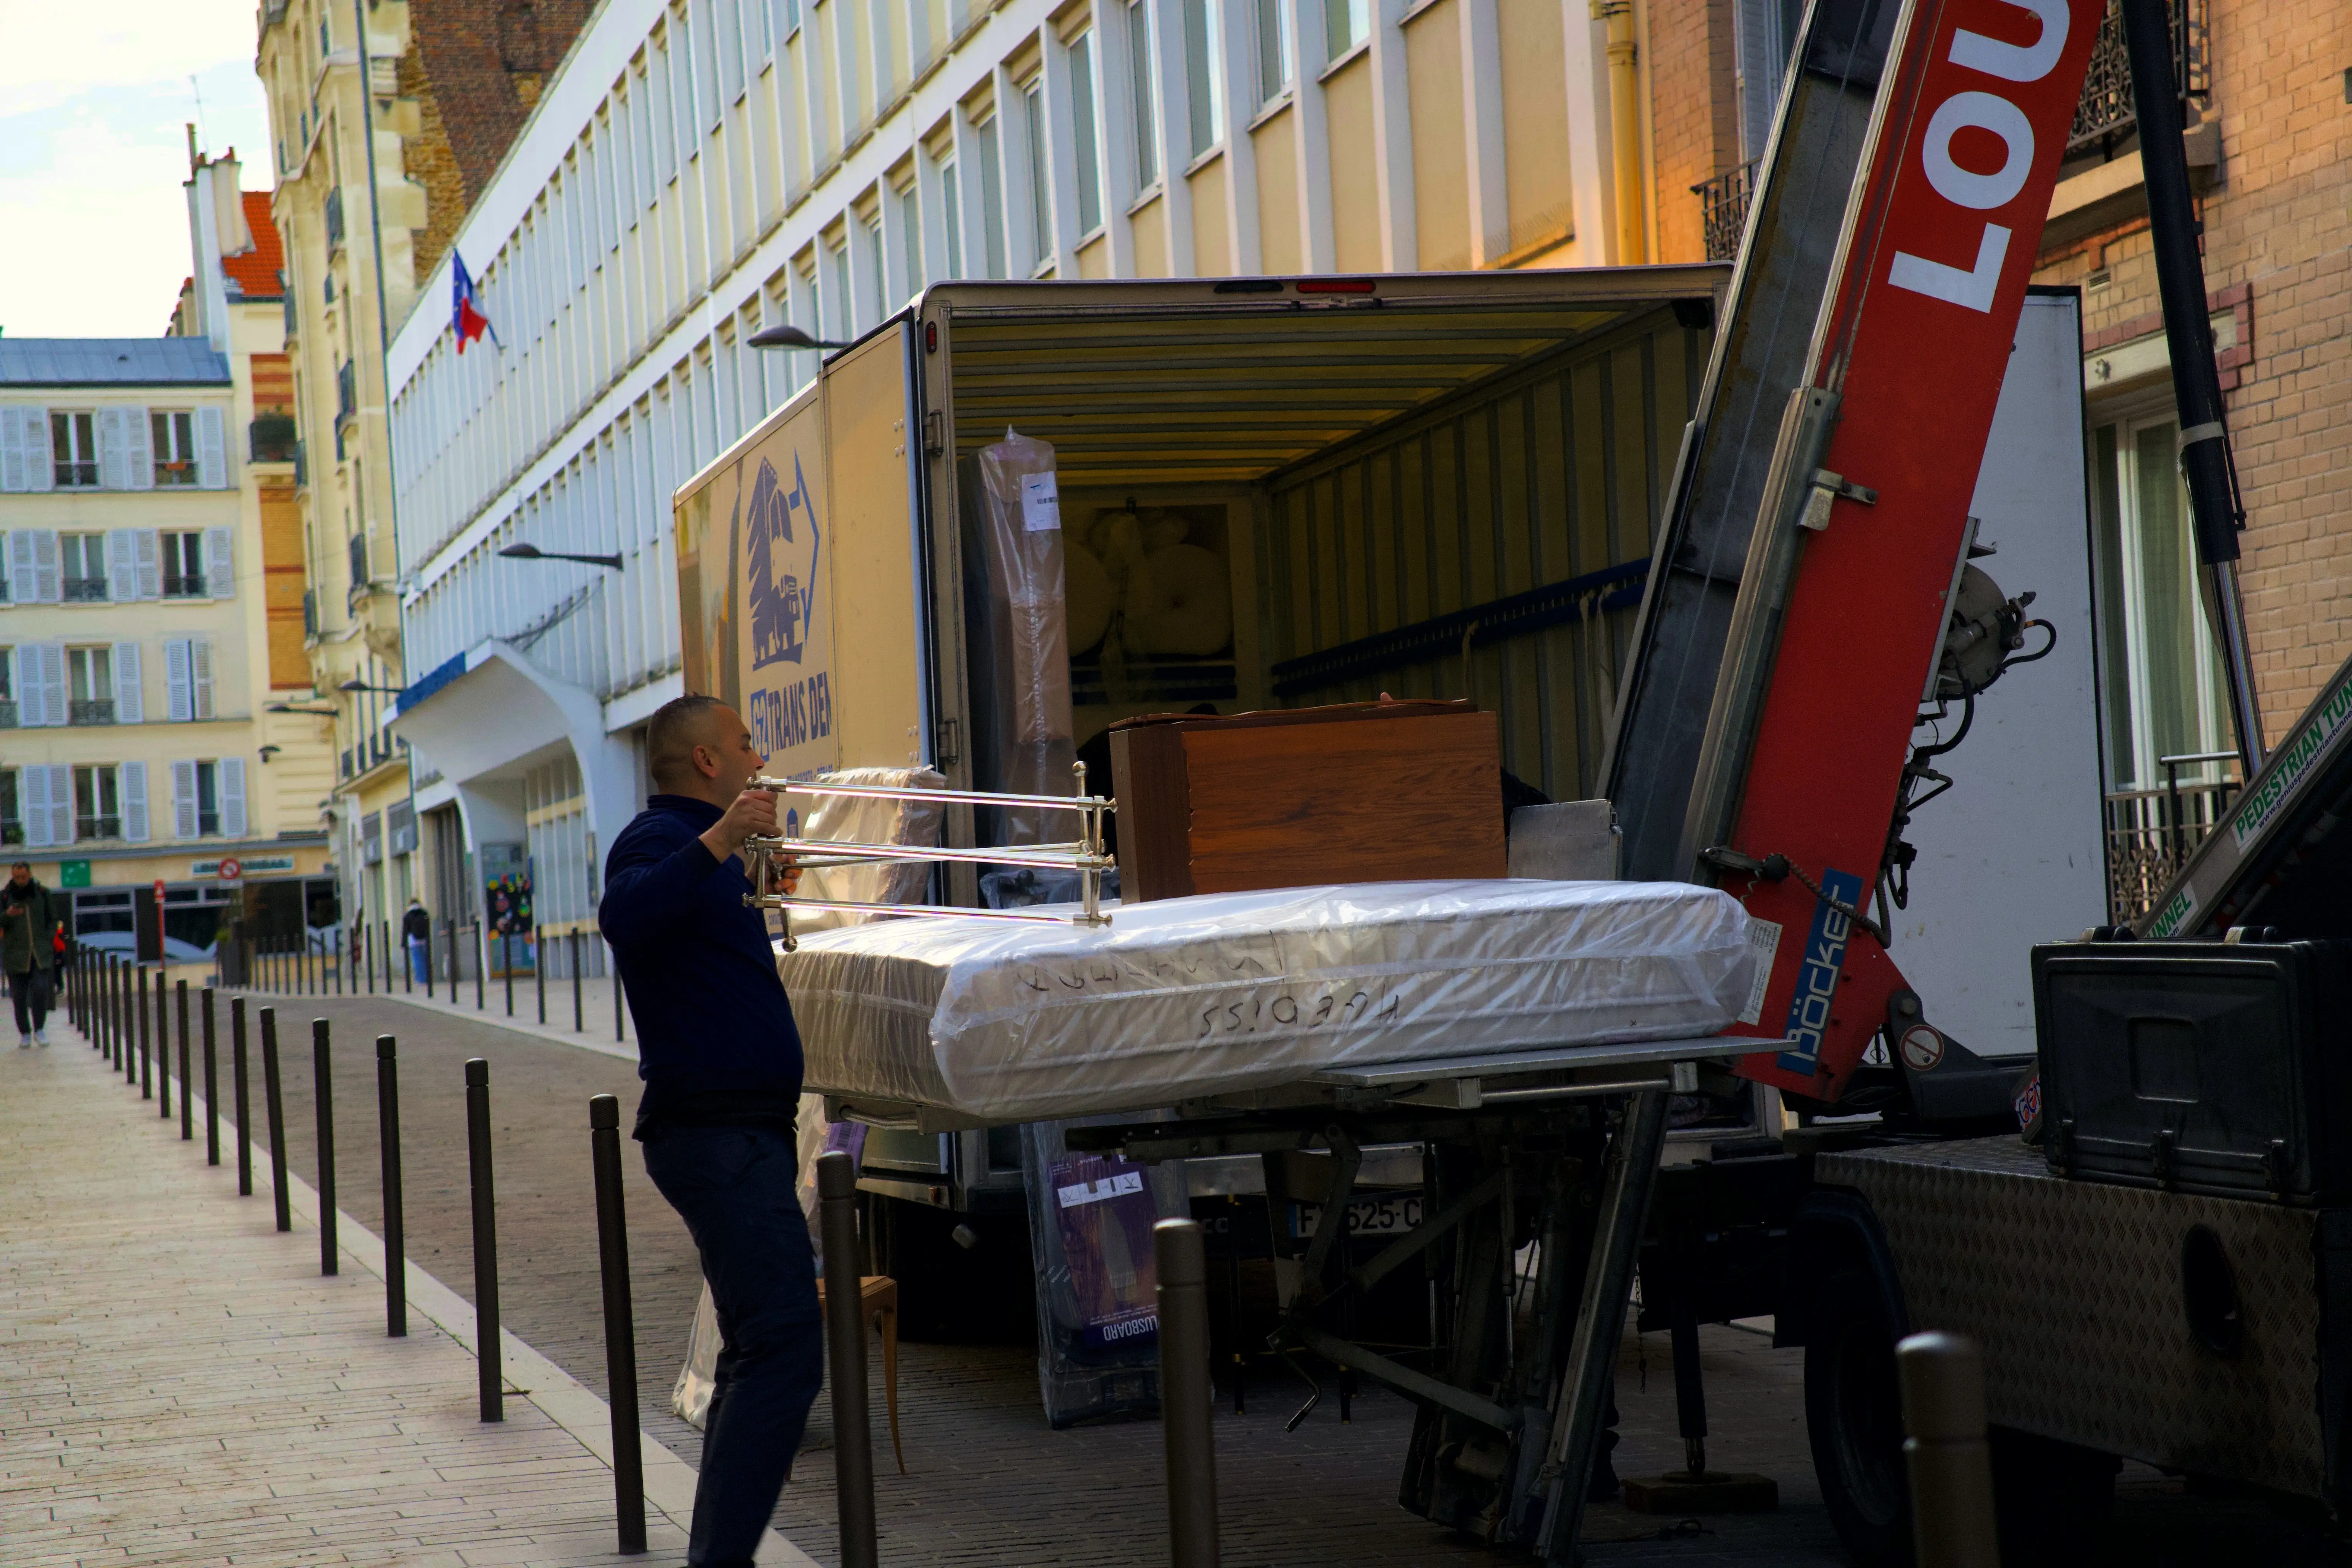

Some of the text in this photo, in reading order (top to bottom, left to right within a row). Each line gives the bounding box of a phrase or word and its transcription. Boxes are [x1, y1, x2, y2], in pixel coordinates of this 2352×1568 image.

[768, 680, 806, 752] TRANS
[2235, 720, 2324, 841] PEDESTRIAN
[1103, 1315, 1160, 1341] LUSBOARD
